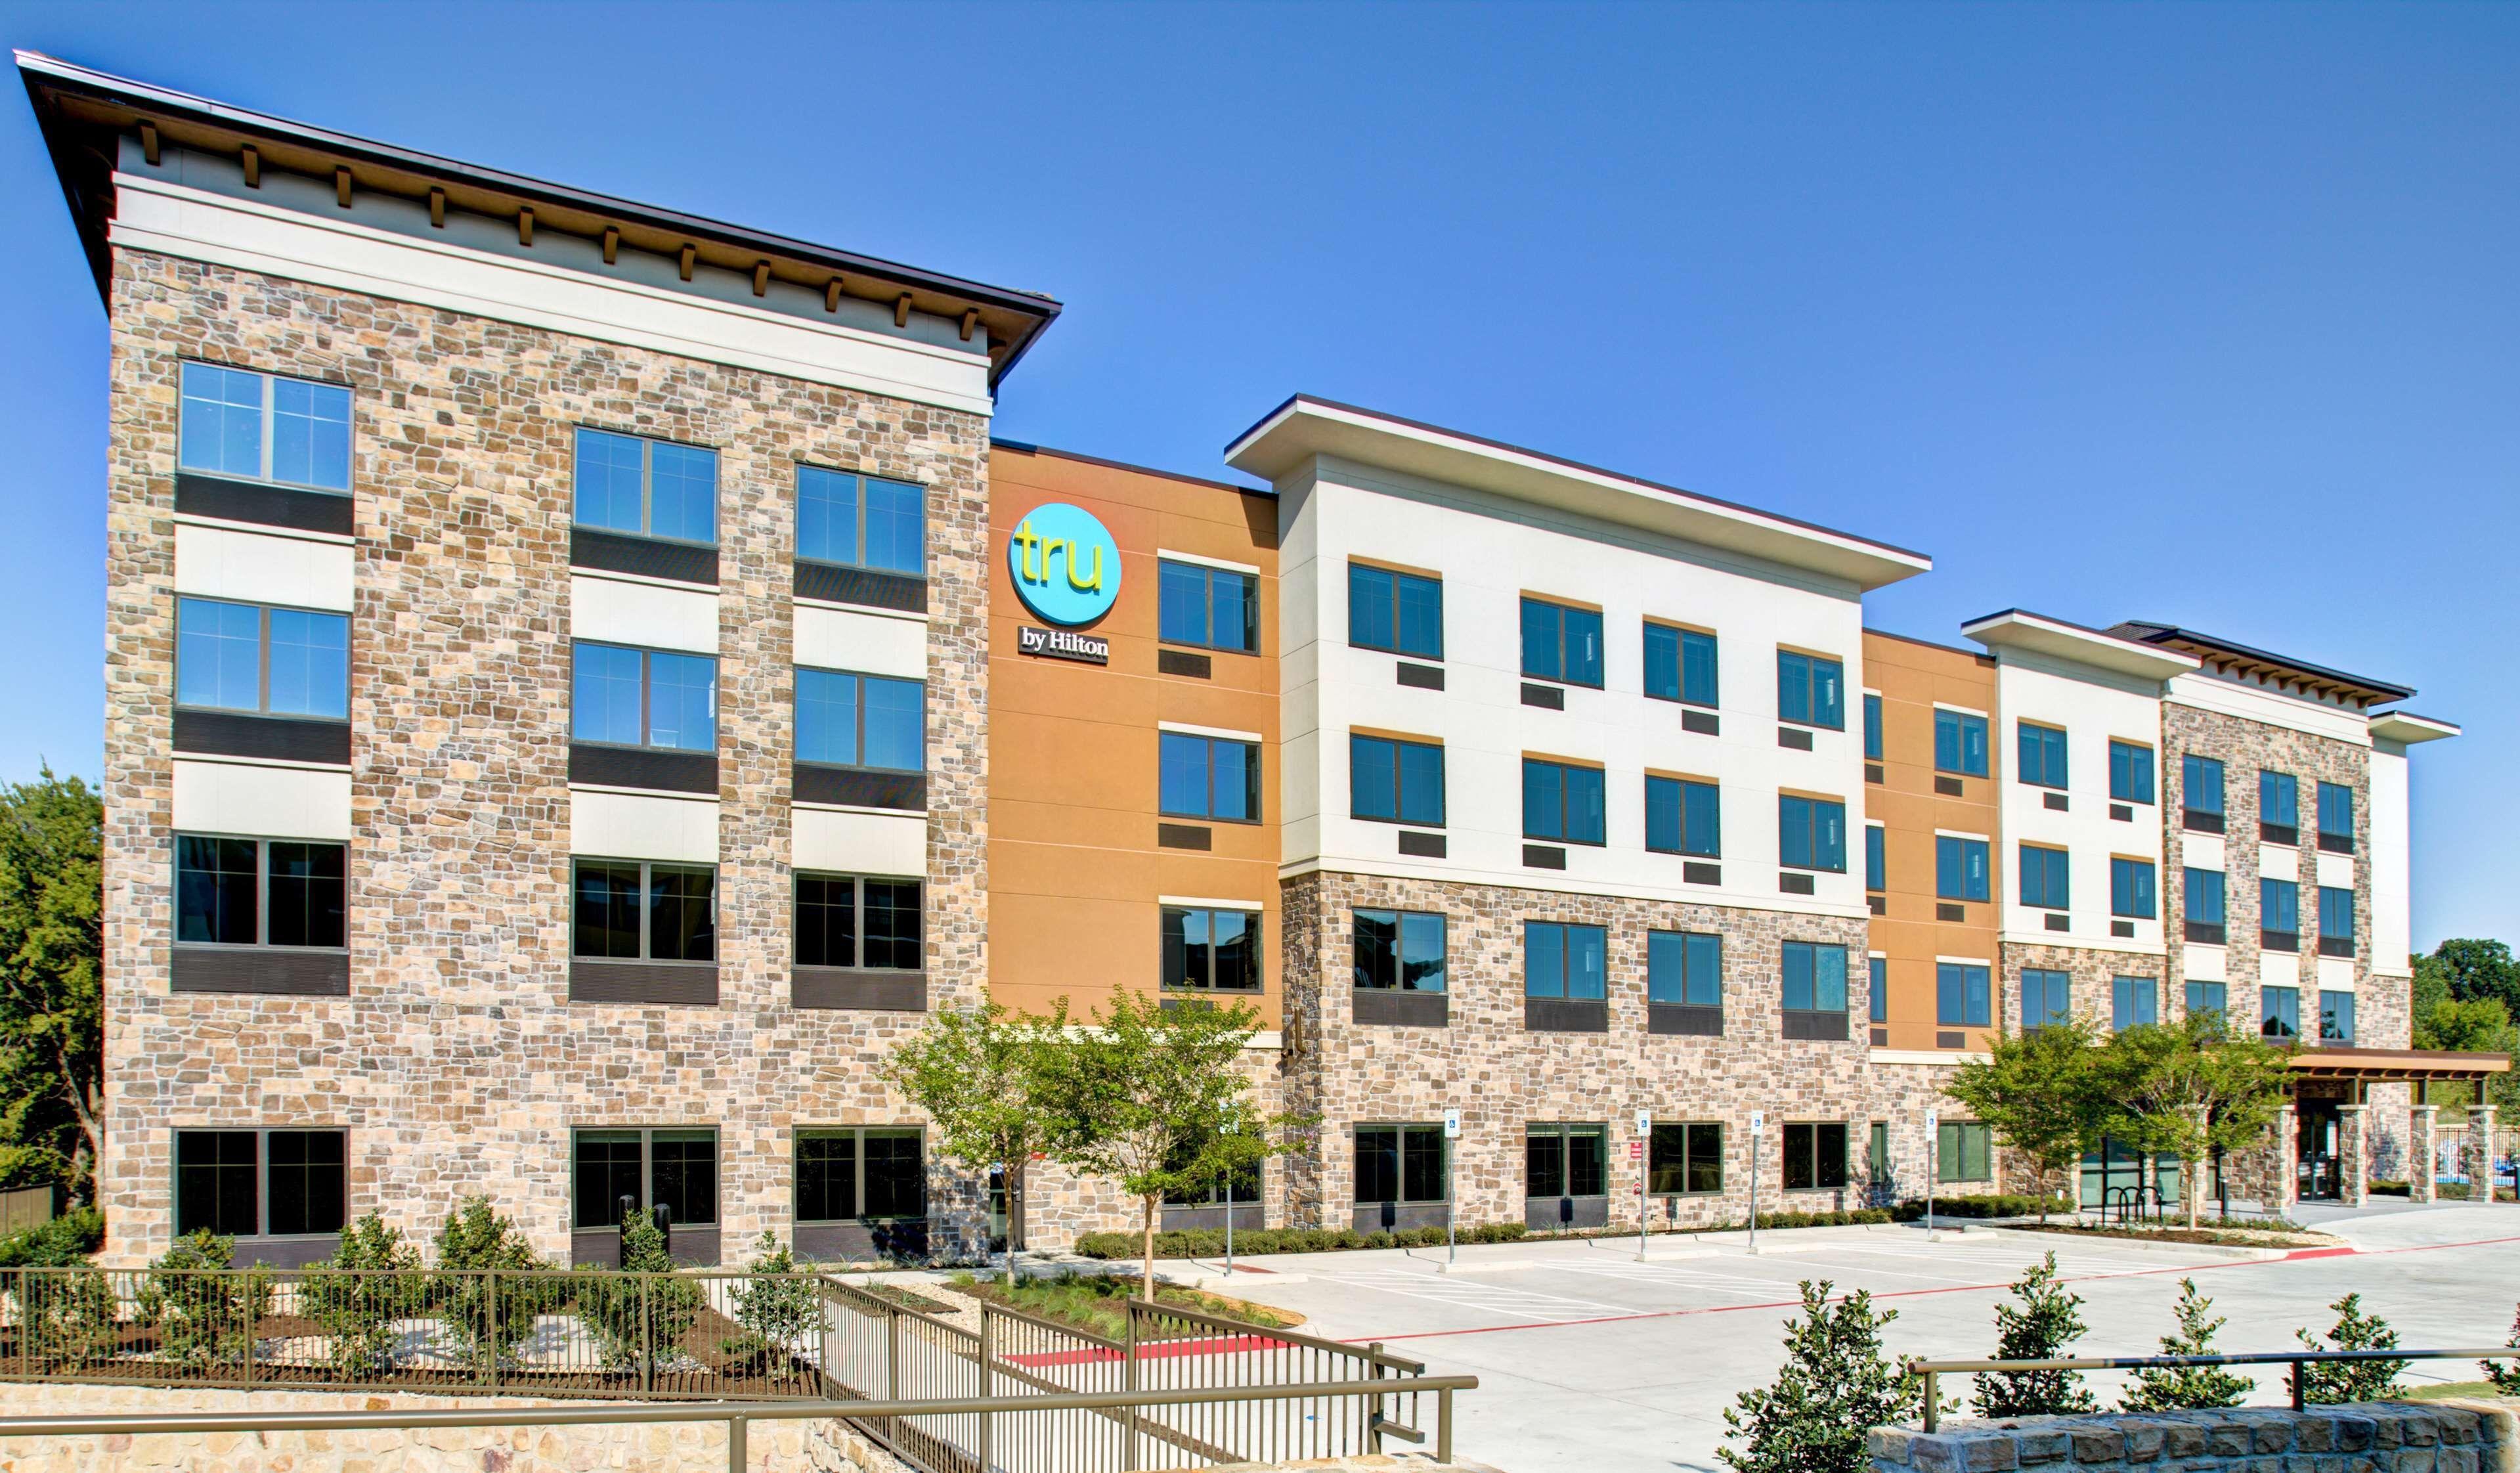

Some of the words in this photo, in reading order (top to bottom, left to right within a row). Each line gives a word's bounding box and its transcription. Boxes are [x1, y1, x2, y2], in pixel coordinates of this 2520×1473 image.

[1014, 519, 1103, 590] tru
[1021, 627, 1046, 651] by
[1049, 630, 1109, 656] Hilton
